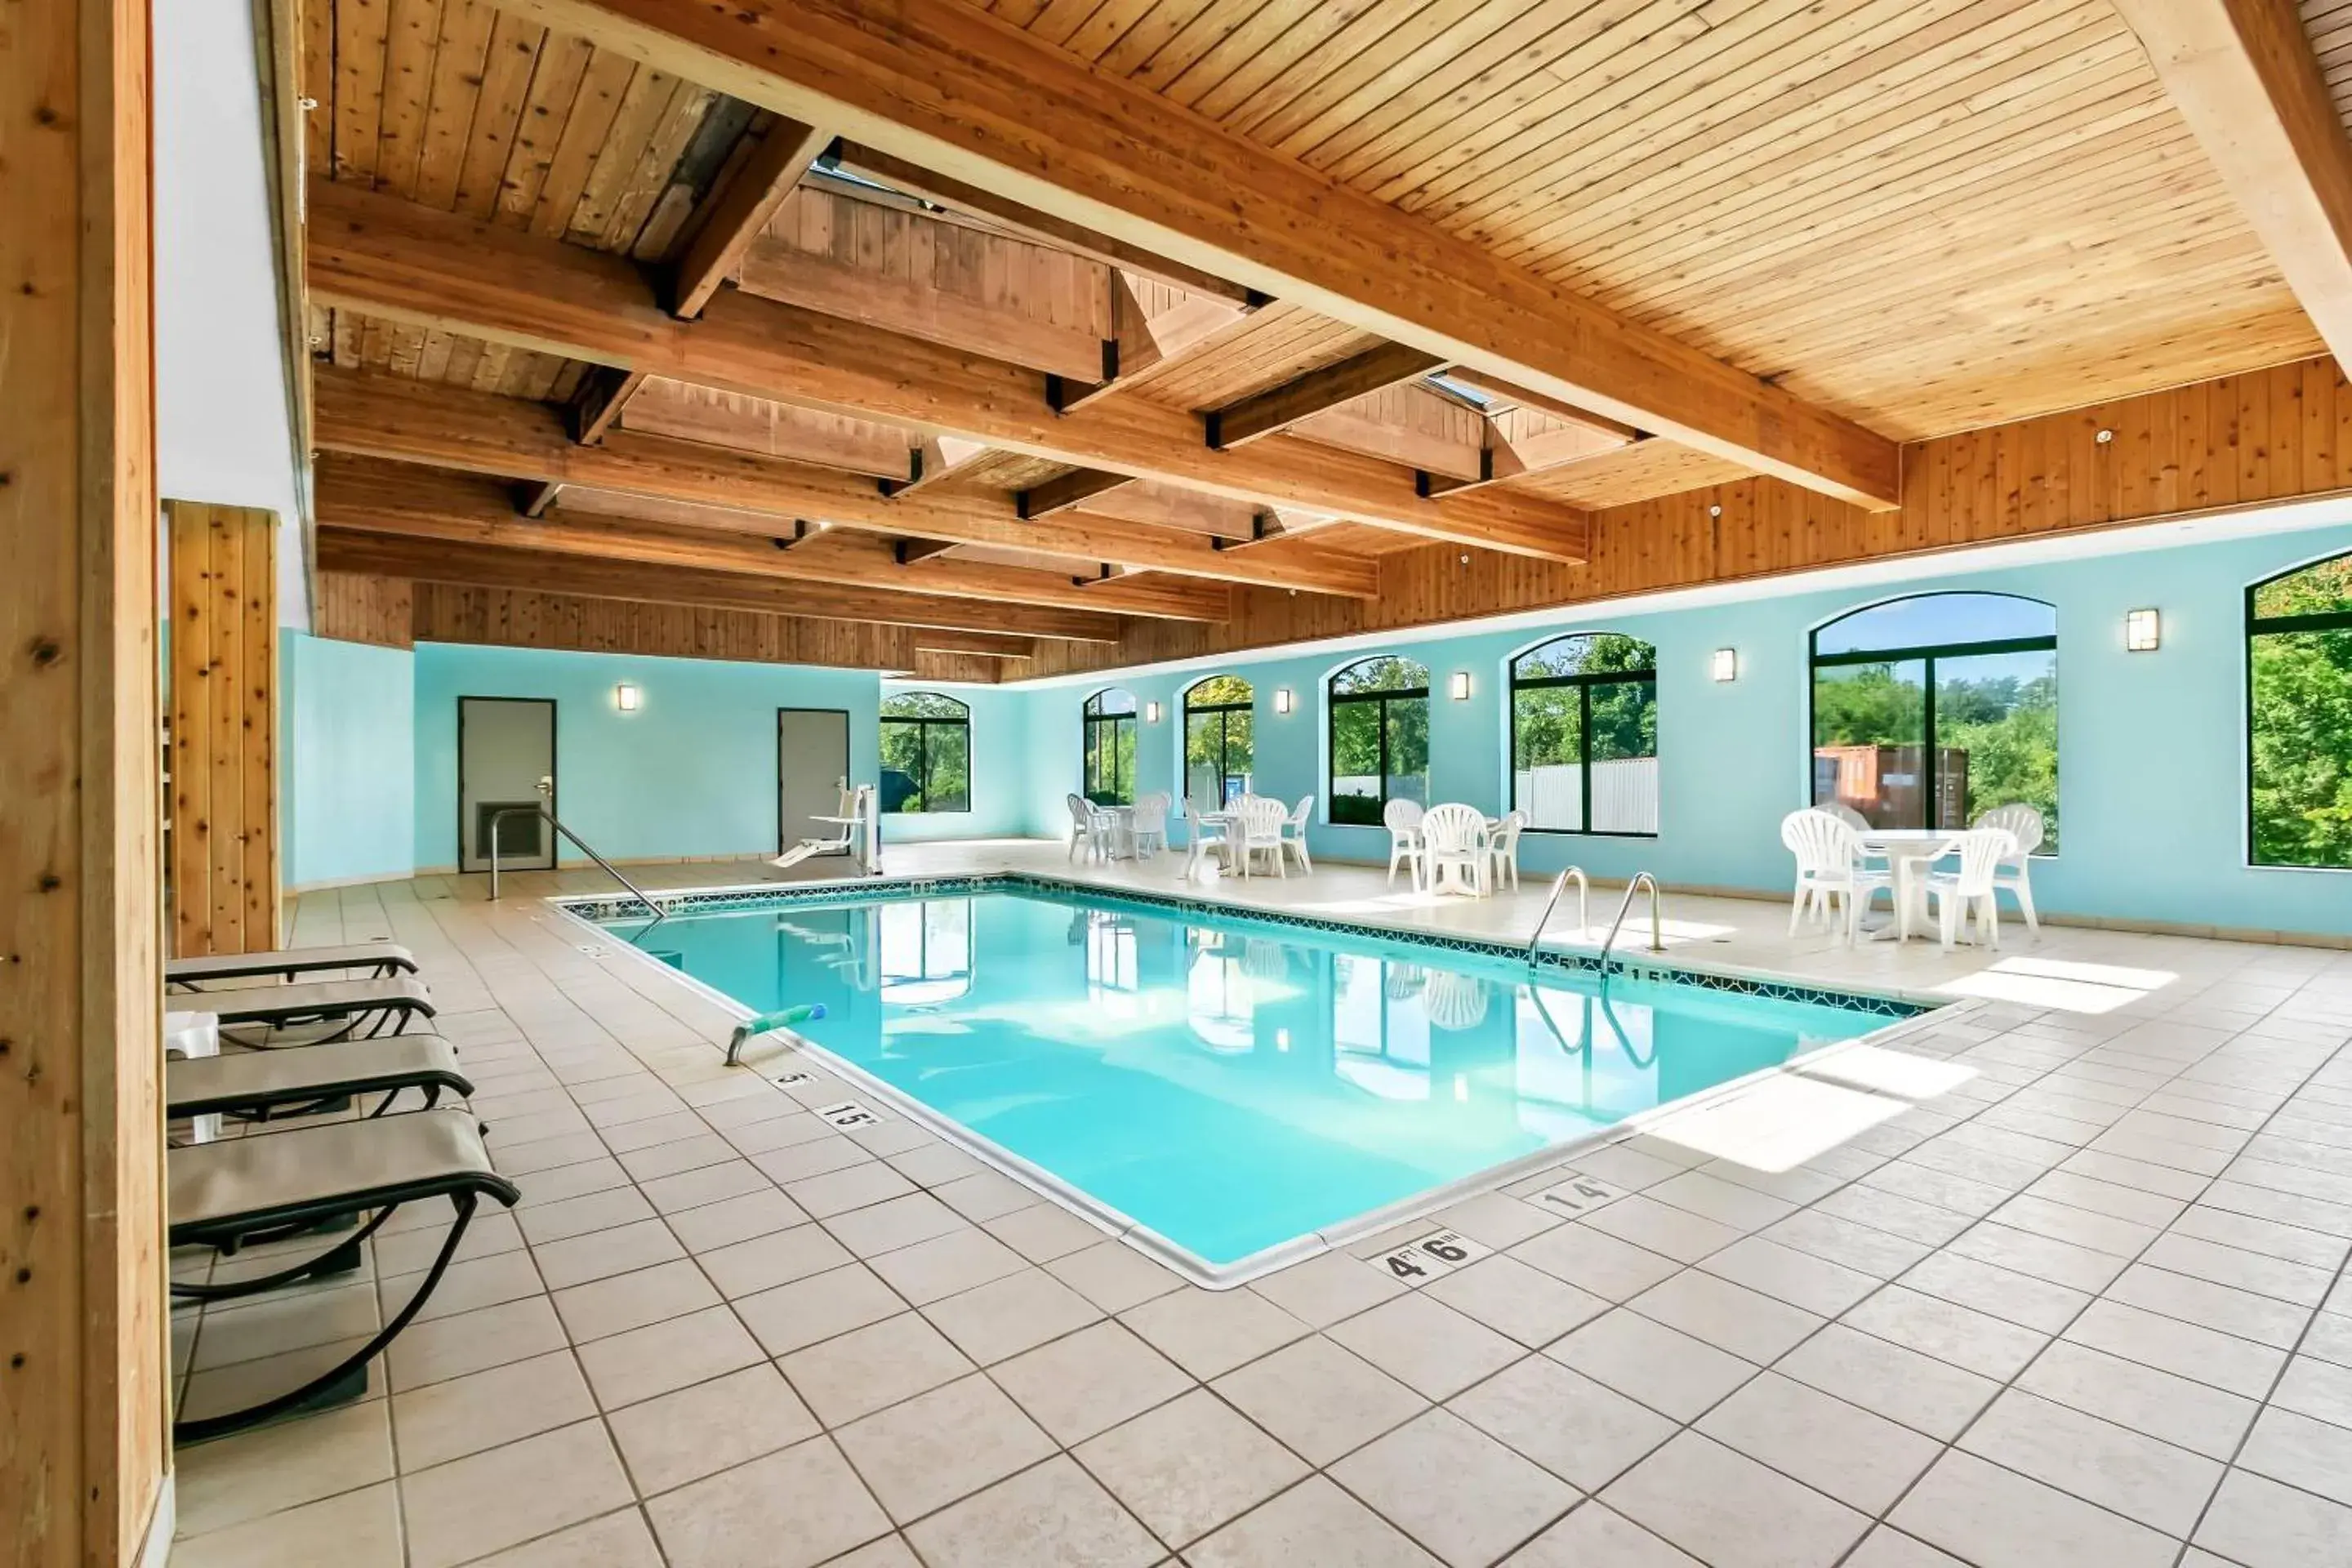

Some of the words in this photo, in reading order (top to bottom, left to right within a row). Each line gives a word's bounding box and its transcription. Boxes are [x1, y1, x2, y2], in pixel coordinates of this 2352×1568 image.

[1544, 1183, 1610, 1209] 14
[1386, 1256, 1428, 1277] 4
[1422, 1240, 1468, 1262] 6
